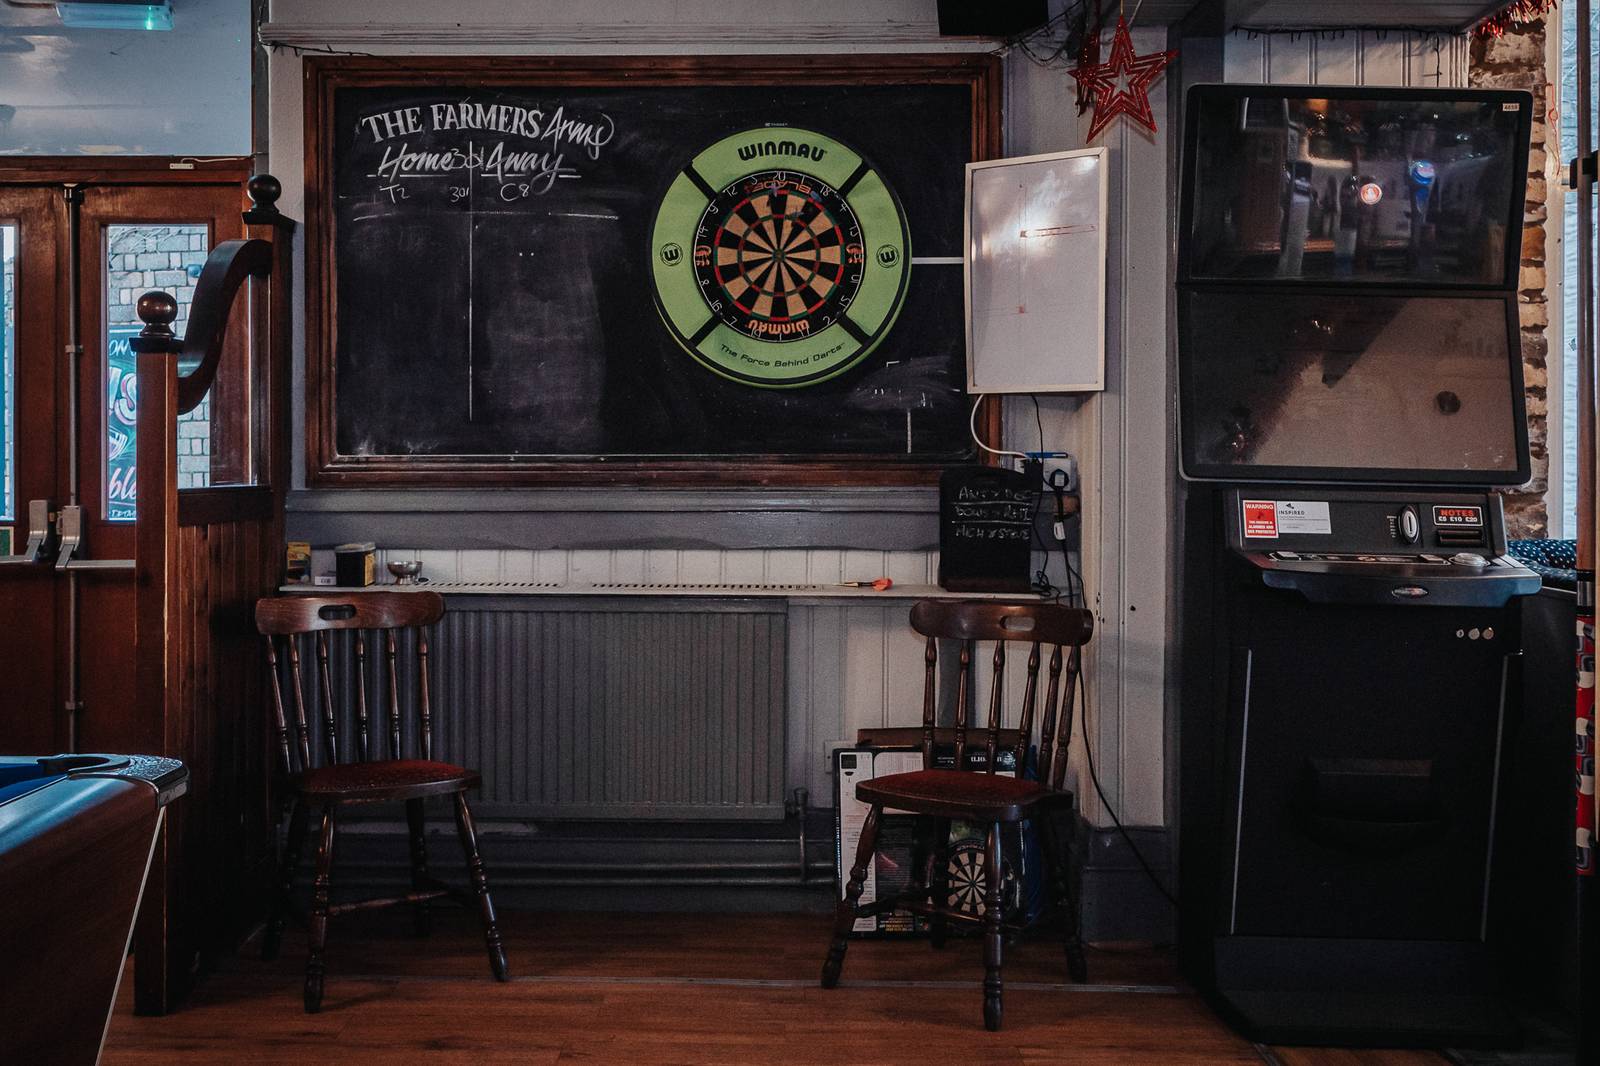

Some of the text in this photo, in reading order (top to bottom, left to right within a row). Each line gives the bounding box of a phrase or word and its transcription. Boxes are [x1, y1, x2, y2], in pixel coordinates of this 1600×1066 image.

[362, 107, 423, 143] THE
[430, 103, 544, 138] FARMERS
[738, 141, 825, 161] WINMAU
[378, 143, 455, 183] Home
[486, 142, 577, 195] Away
[500, 183, 530, 202] C8
[721, 344, 738, 357] The
[741, 354, 770, 367] Force
[775, 357, 809, 367] Behind
